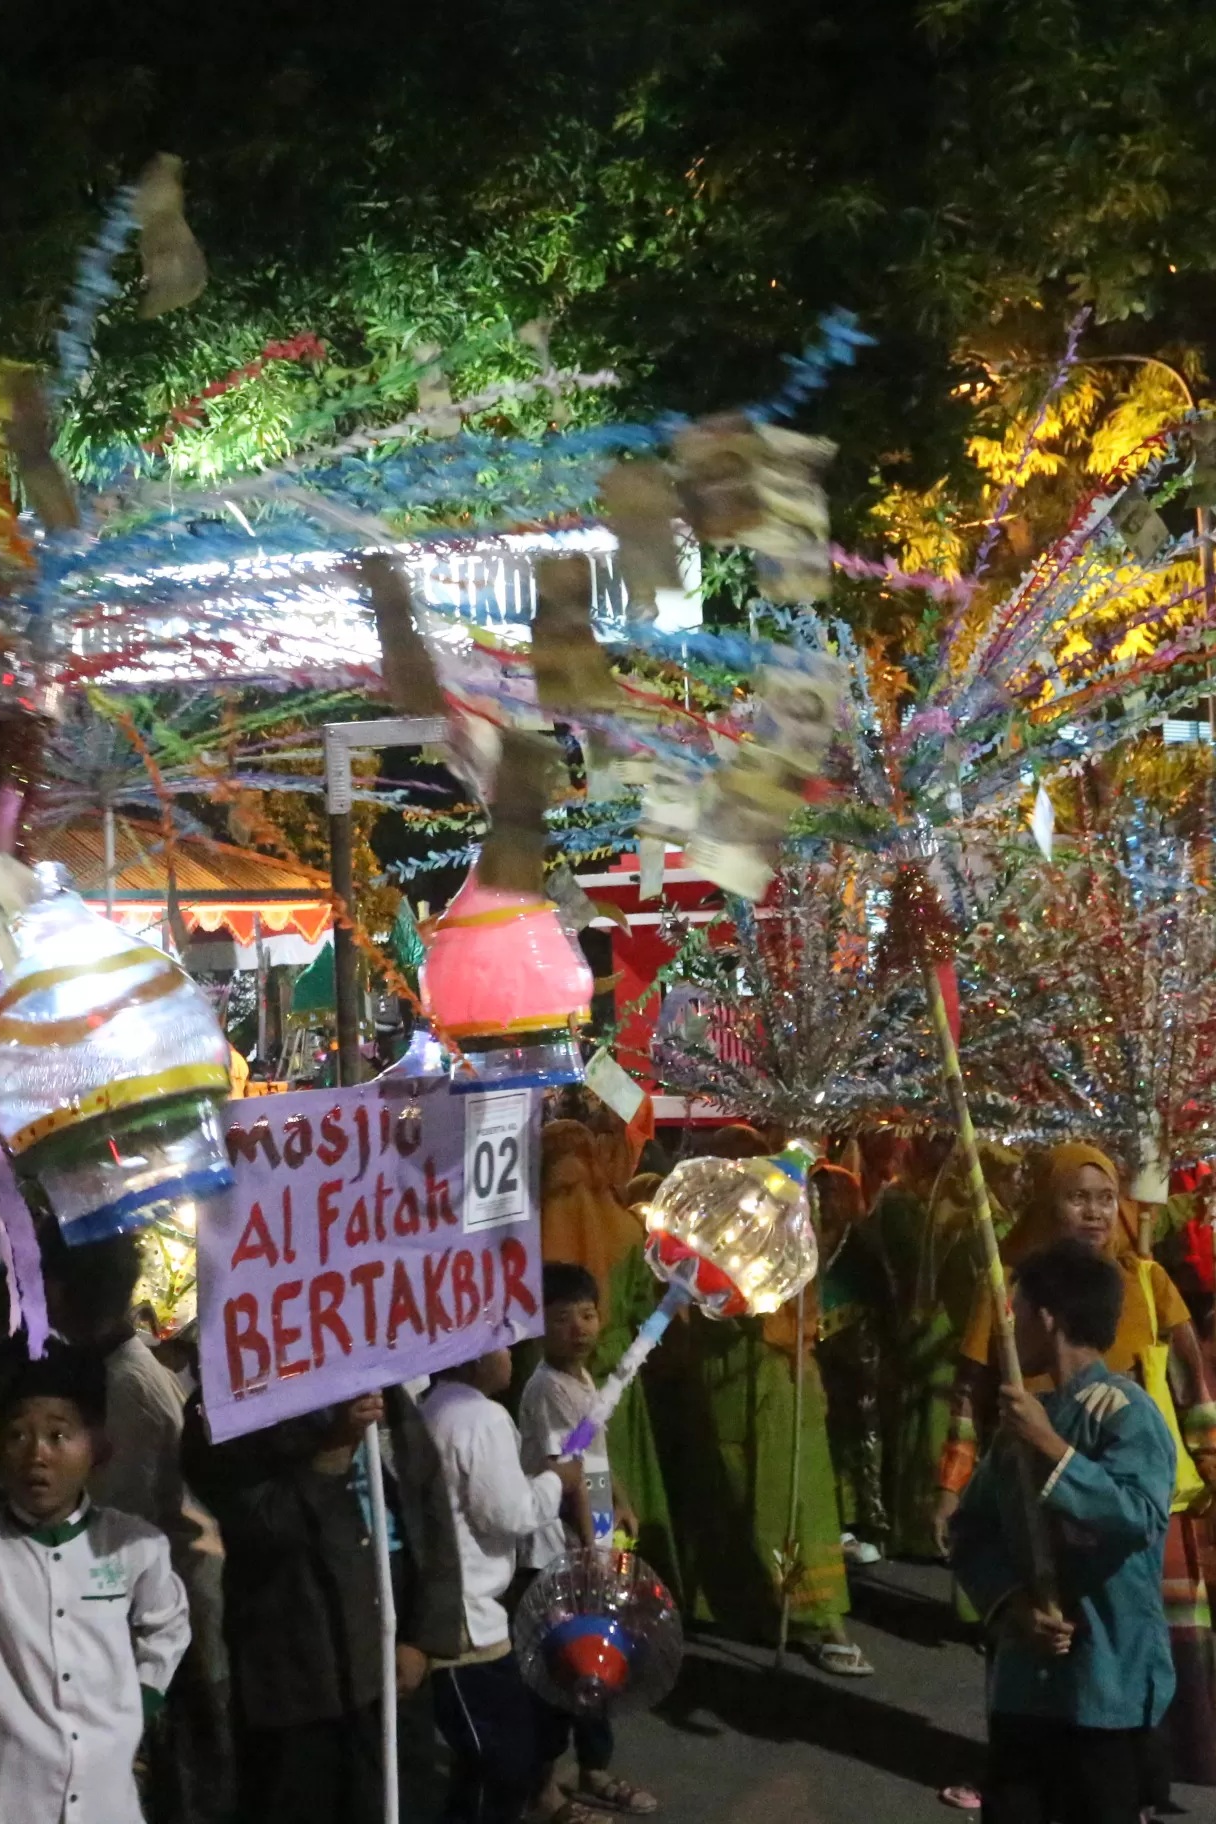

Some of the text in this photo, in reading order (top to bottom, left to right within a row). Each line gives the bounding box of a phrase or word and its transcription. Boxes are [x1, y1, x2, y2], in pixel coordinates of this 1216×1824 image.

[473, 1136, 518, 1199] 02
[231, 1185, 296, 1271] Al
[224, 1237, 538, 1399] BERTAKBIR
